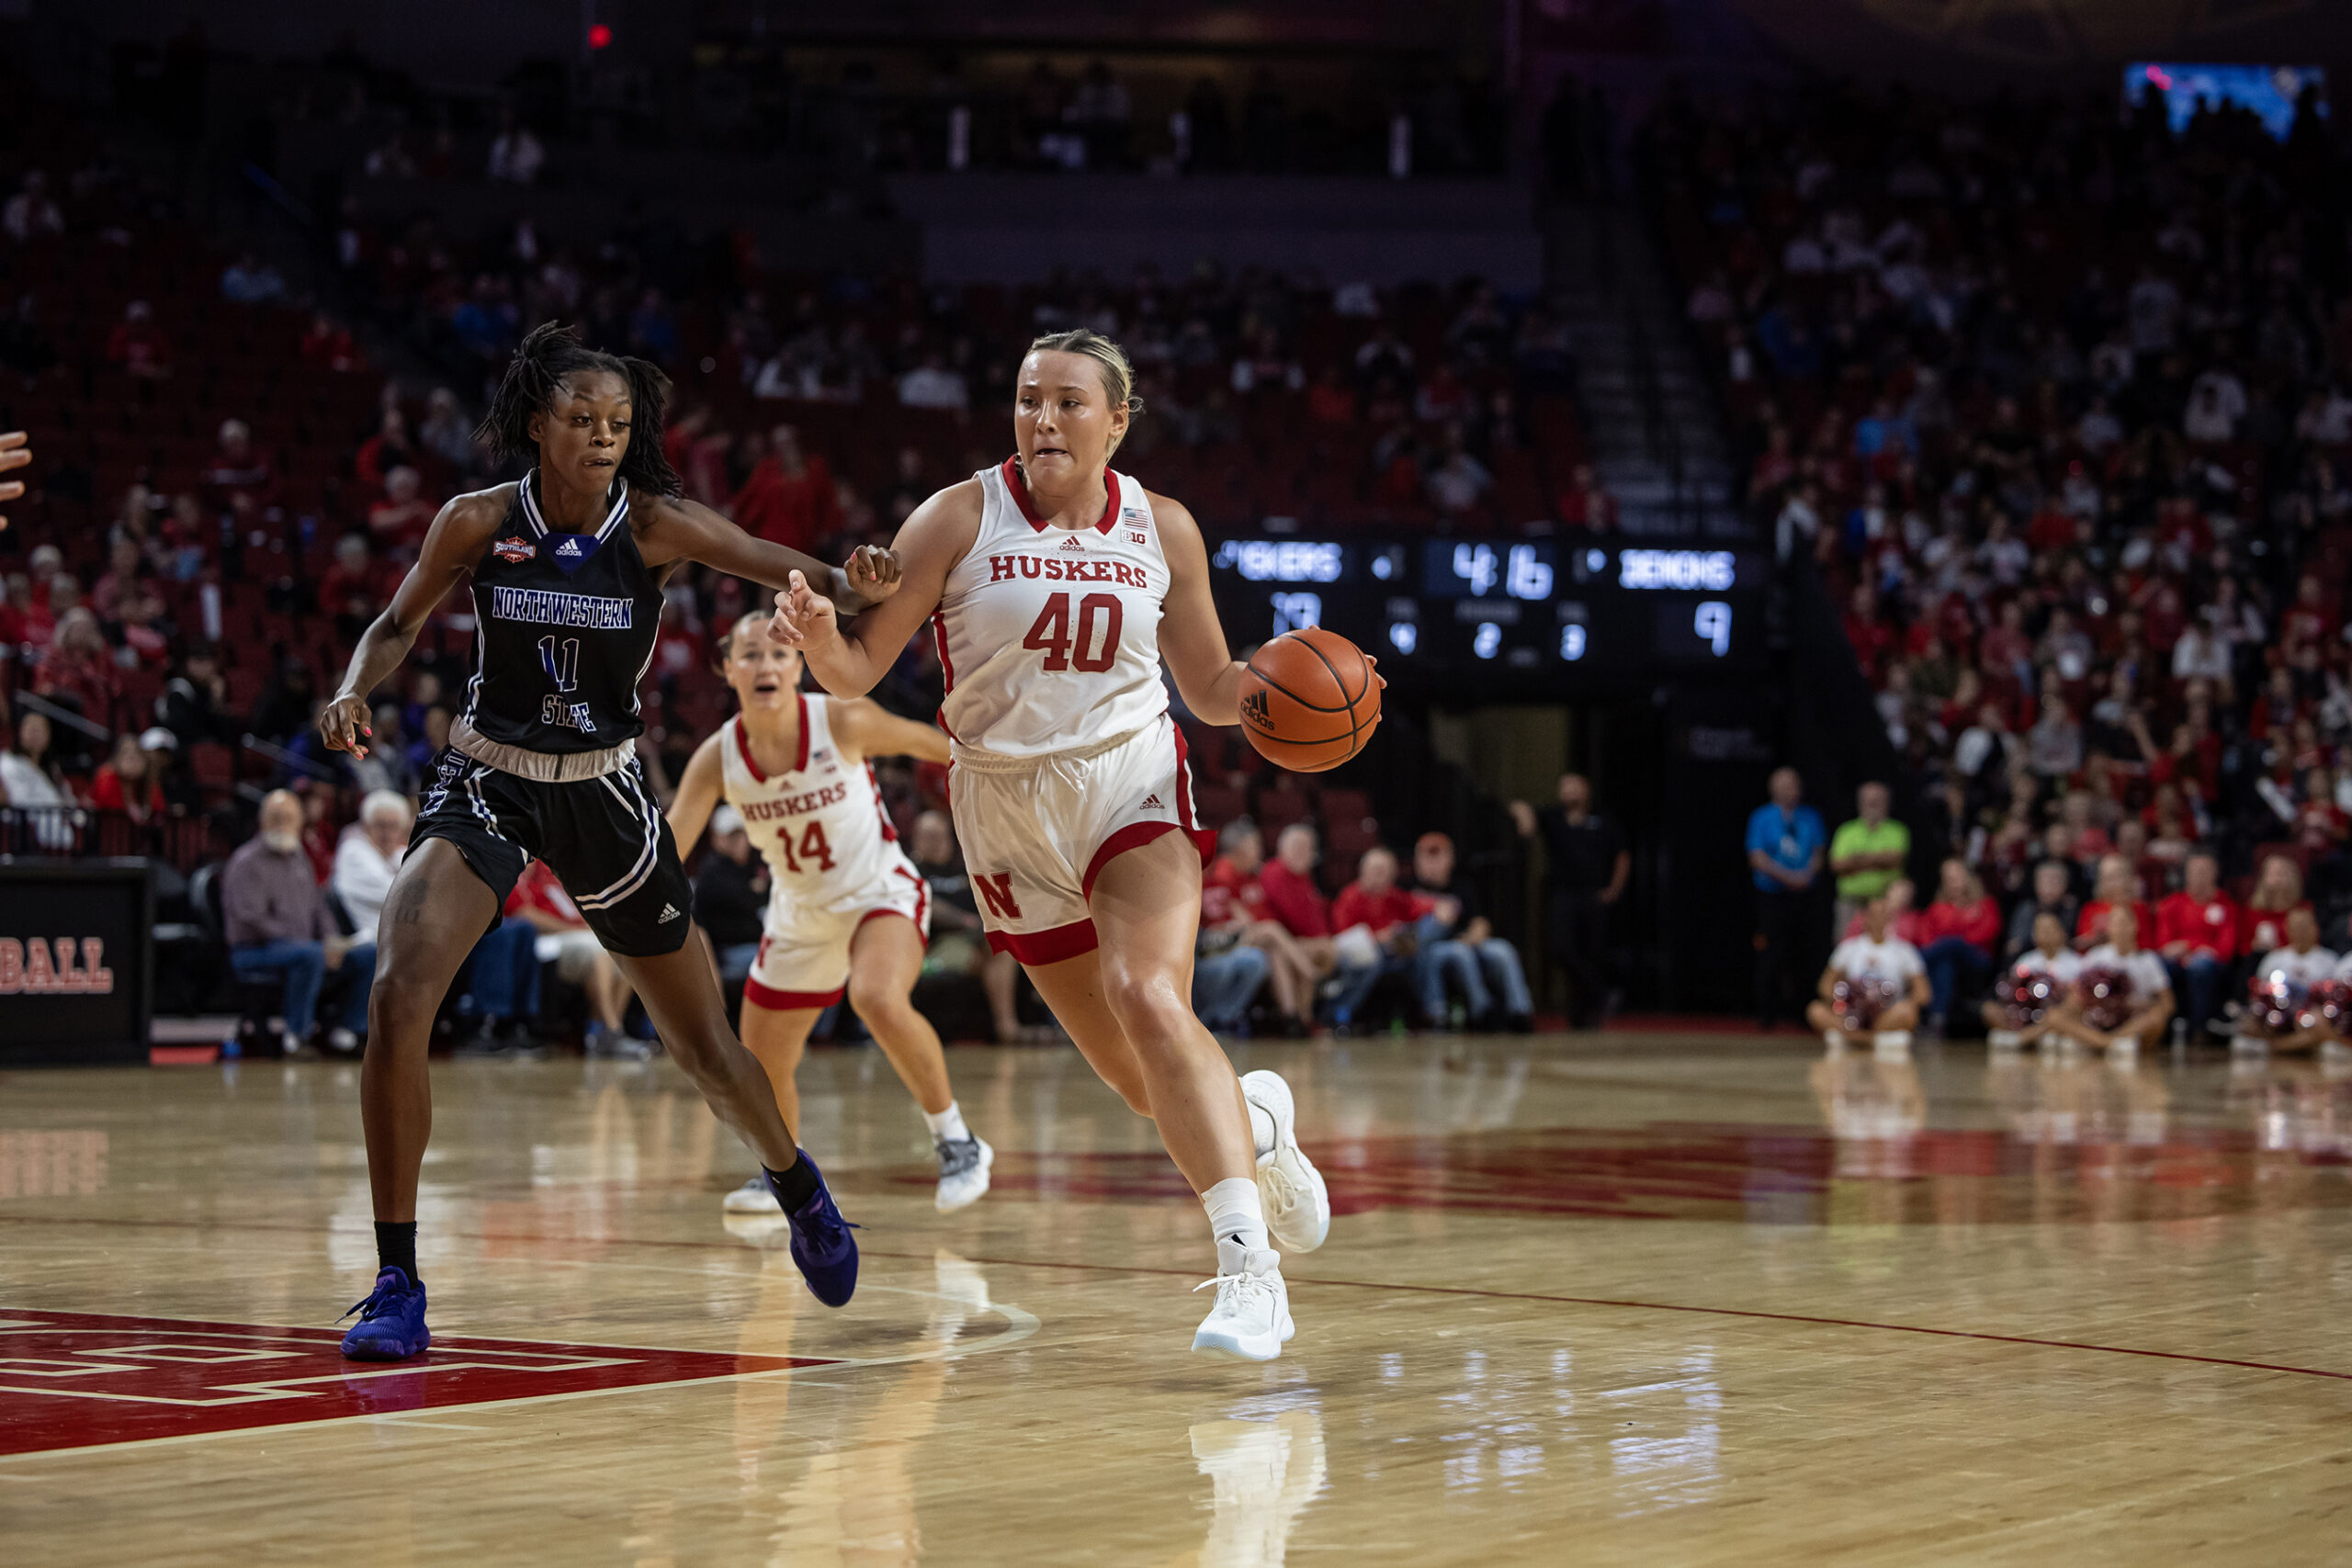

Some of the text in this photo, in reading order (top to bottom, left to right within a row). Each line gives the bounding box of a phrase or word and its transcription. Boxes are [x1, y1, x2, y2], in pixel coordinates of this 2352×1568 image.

[495, 542, 535, 558] SOUTHLAND
[555, 548, 582, 557] adidas
[1058, 544, 1085, 552] adidas
[989, 556, 1147, 589] HUSKERS
[492, 585, 634, 629] NORTHWESTERN
[1023, 592, 1124, 673] 40
[1695, 601, 1733, 658] 9
[537, 635, 580, 692] 11
[1240, 700, 1275, 731] adidas
[741, 781, 847, 822] HUSKERS
[1138, 802, 1166, 810] adidas
[776, 820, 837, 873] 14
[971, 870, 1023, 919] N
[658, 909, 682, 925] adidas
[0, 936, 114, 994] BALL
